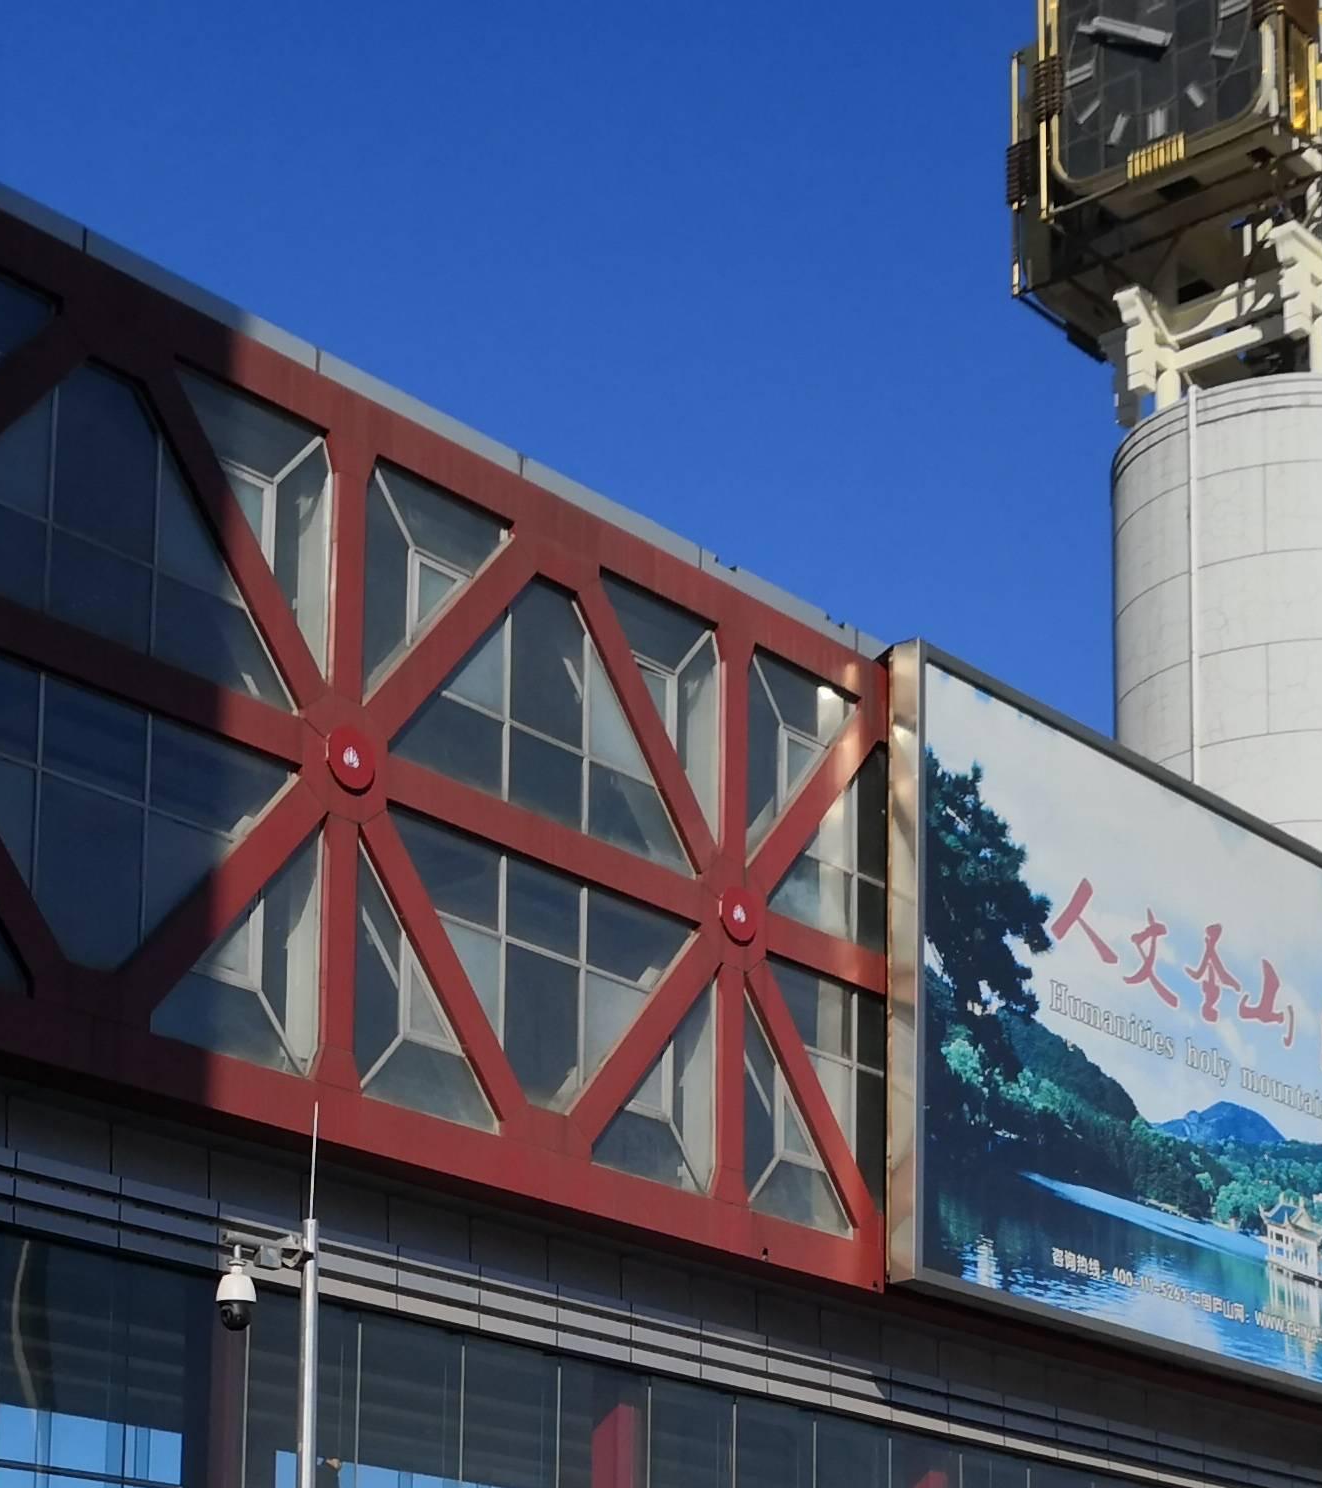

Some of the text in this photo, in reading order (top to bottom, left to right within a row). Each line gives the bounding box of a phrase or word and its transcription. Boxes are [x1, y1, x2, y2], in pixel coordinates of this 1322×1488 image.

[1050, 877, 1295, 1050] 人文圣山
[1049, 980, 1175, 1059] Humanities
[1185, 1037, 1231, 1088] holy
